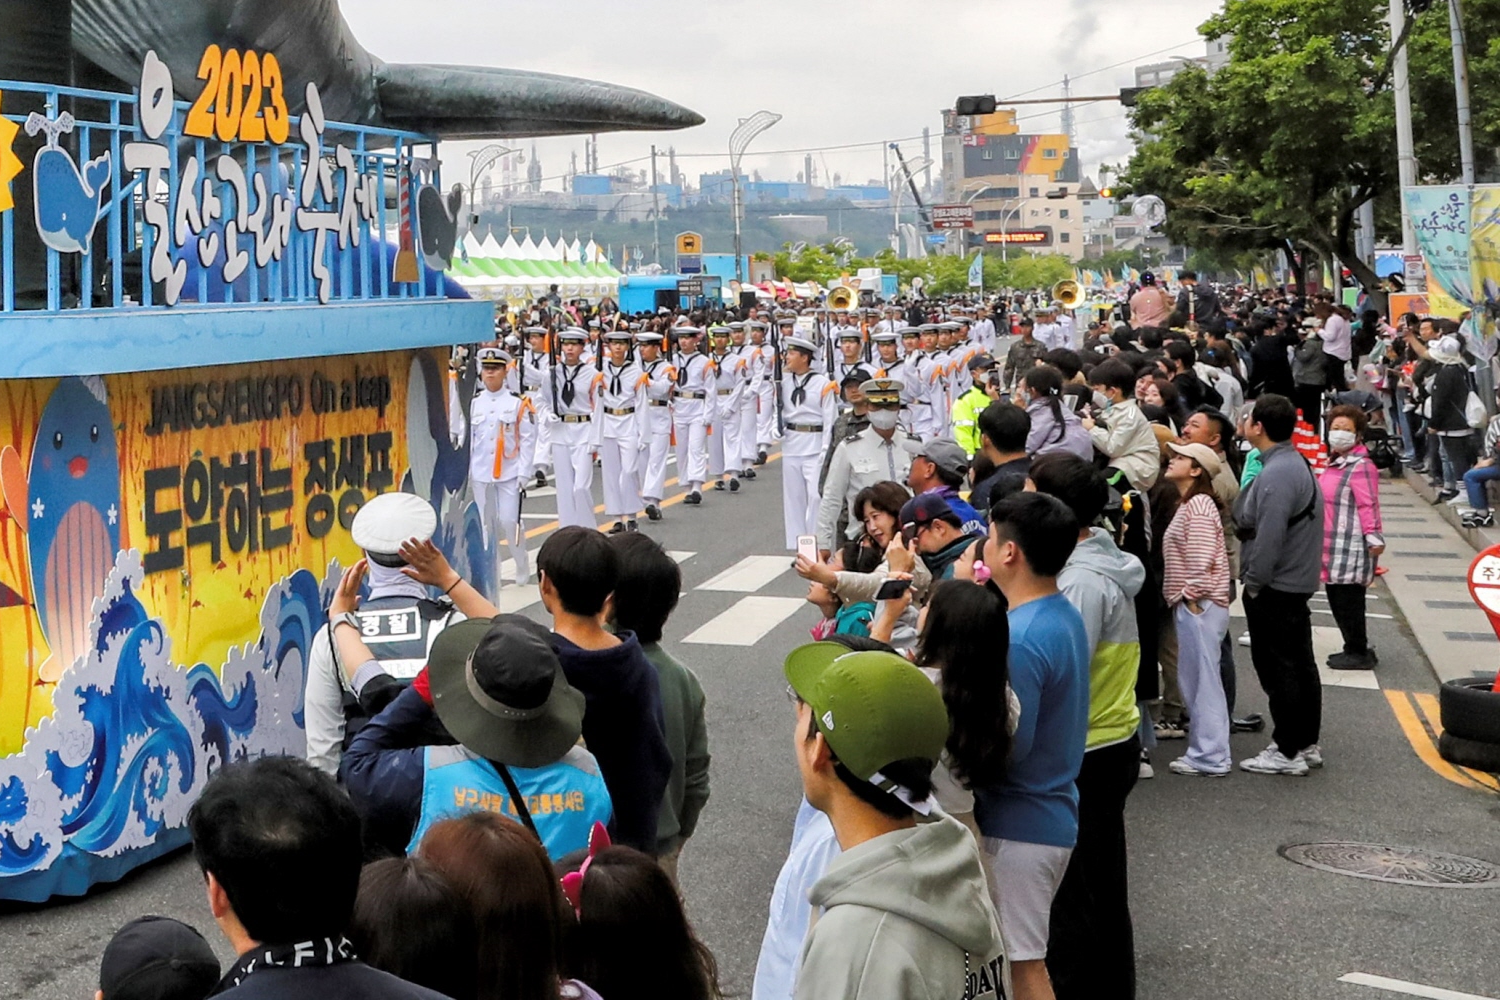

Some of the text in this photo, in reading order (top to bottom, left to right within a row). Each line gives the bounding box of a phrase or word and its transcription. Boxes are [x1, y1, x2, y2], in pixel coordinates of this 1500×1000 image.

[183, 43, 290, 145] 2023
[144, 364, 392, 436] JANGSAENGPO On a leap
[143, 431, 394, 576] 도약하는 장생포
[1482, 566, 1500, 582] 주
[361, 614, 409, 636] 경찰
